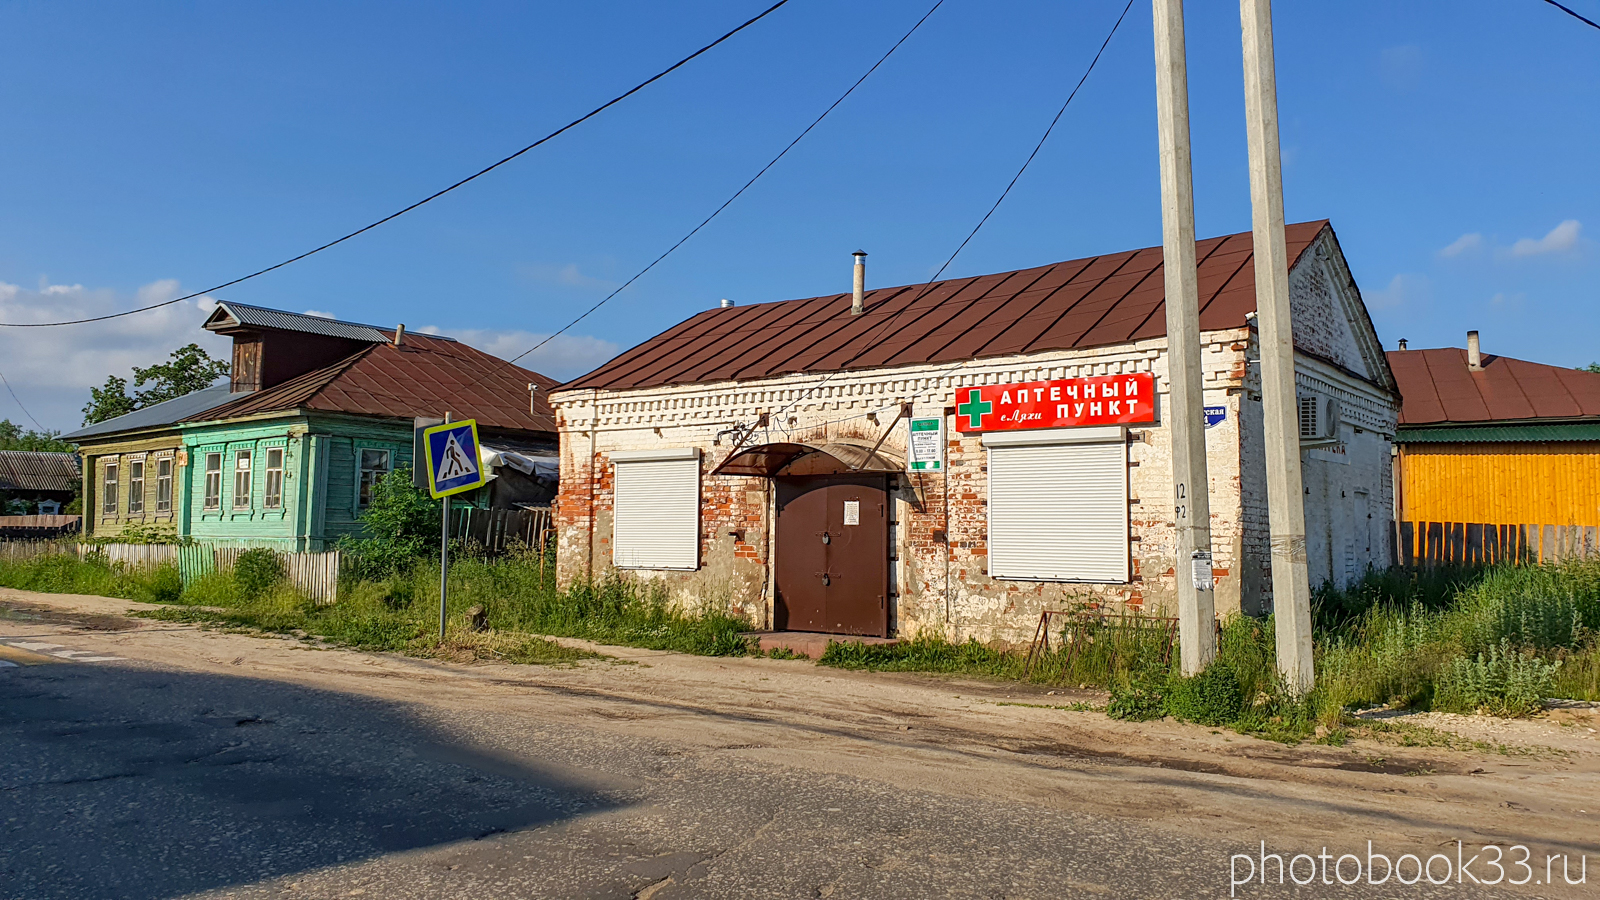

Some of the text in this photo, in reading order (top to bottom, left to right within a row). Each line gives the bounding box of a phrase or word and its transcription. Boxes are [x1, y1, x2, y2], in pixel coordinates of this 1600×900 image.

[1000, 379, 1138, 404] АПТЕЧНЫЙ
[1056, 399, 1139, 418] ПУНКТ
[1176, 483, 1186, 499] 12
